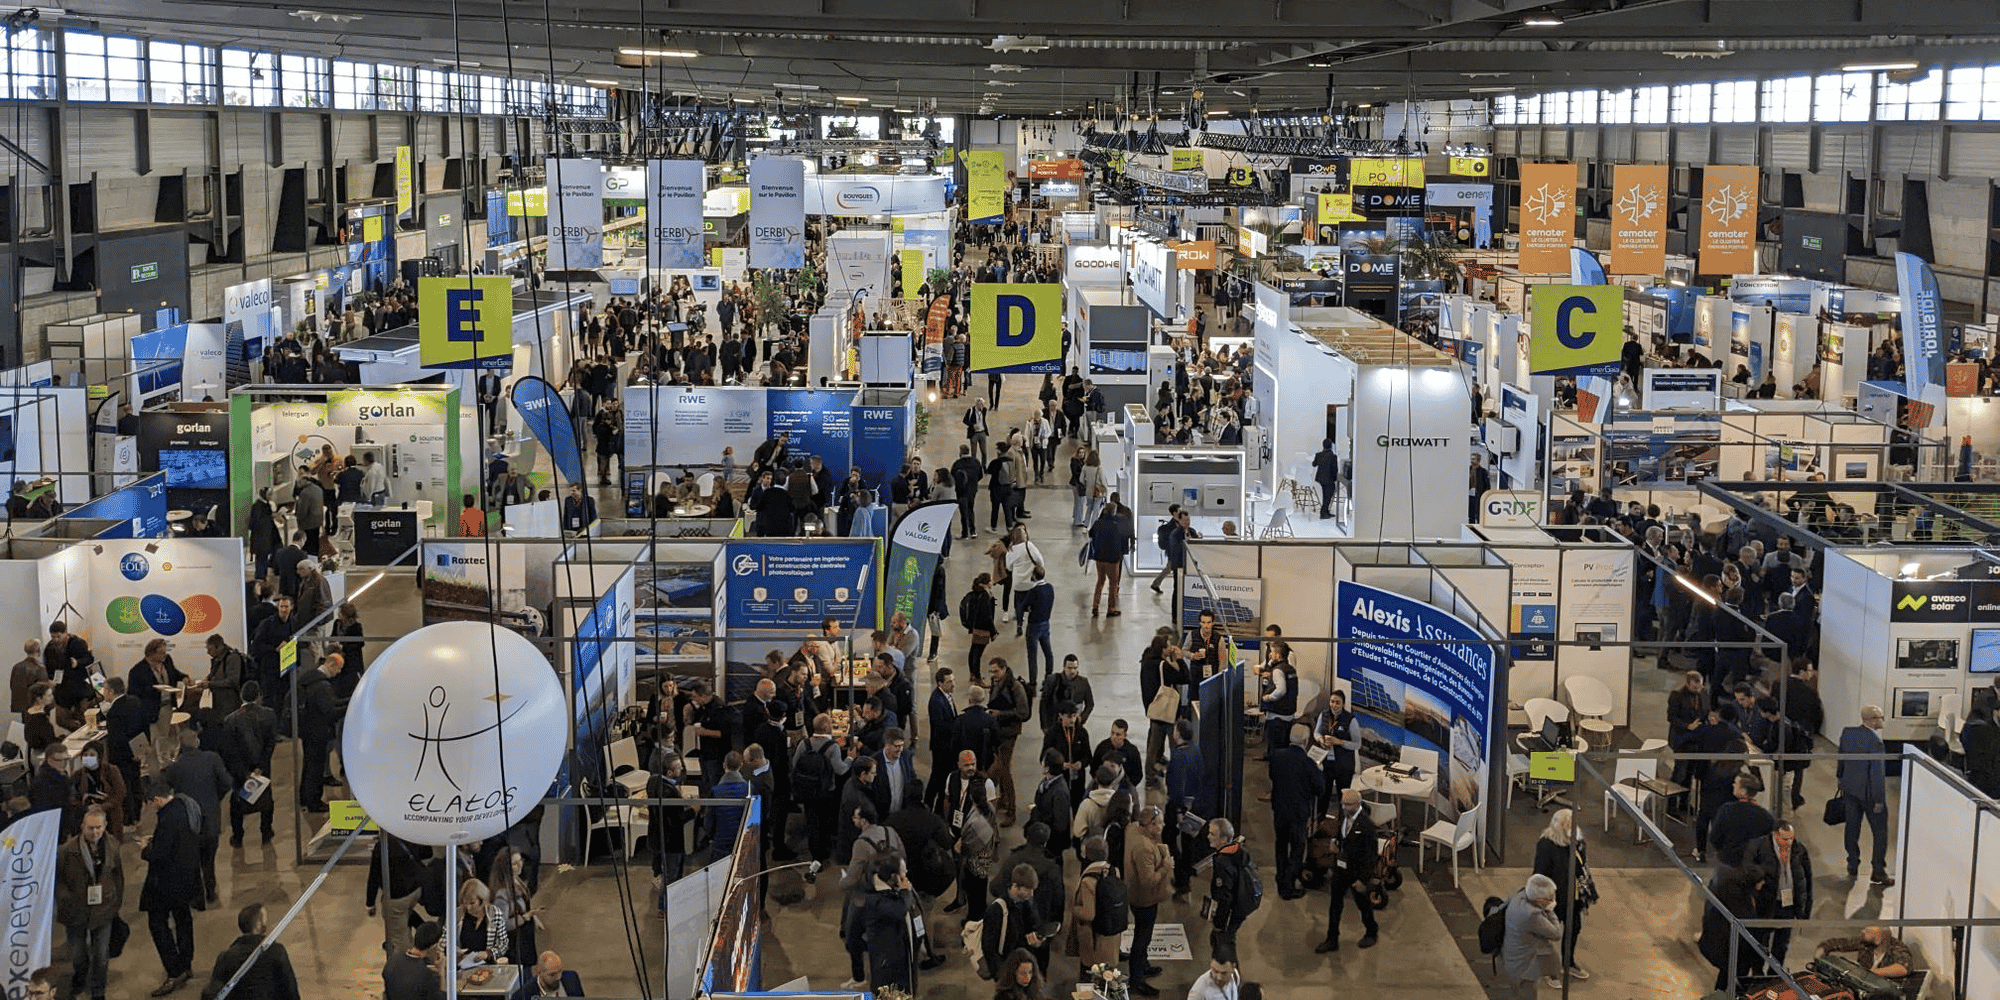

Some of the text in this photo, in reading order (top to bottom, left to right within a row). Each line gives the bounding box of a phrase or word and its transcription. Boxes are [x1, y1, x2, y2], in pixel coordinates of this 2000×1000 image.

[1237, 168, 1246, 181] B
[1041, 186, 1078, 194] OMEXOM
[553, 227, 583, 237] DERBI
[654, 227, 685, 237] DERBI
[755, 227, 786, 237] DERBI
[1075, 260, 1120, 268] GOODWE
[1350, 262, 1394, 273] DOME
[240, 290, 268, 310] valeco
[447, 289, 484, 341] E
[996, 294, 1036, 346] D
[1556, 295, 1597, 349] C
[1031, 363, 1061, 371] enerGaia
[1590, 365, 1620, 373] enerGaia
[679, 395, 706, 403] RWE
[358, 402, 415, 420] gorlan
[863, 410, 894, 419] RWE
[774, 414, 785, 422] 20
[802, 414, 808, 422] 5
[176, 422, 211, 434] gorlan
[1377, 435, 1450, 448] GROWATT
[1488, 501, 1537, 515] GRDF
[371, 519, 401, 529] gorlan
[904, 530, 938, 543] VALOREM
[451, 556, 485, 565] Roxtec
[784, 555, 813, 563] partenaire
[1930, 602, 1956, 611] solar
[1351, 626, 1376, 640] Depuis
[1404, 644, 1432, 662] Courtier
[1352, 597, 1487, 681] Alexis Assurances
[1351, 646, 1382, 662] d'Etudes
[1382, 656, 1422, 680] Techniques,
[1422, 673, 1432, 683] de
[1405, 655, 1414, 665] de
[404, 813, 454, 824] ACCOMPANYING
[455, 814, 474, 824] YOUR
[2, 839, 39, 1000] exenergies
